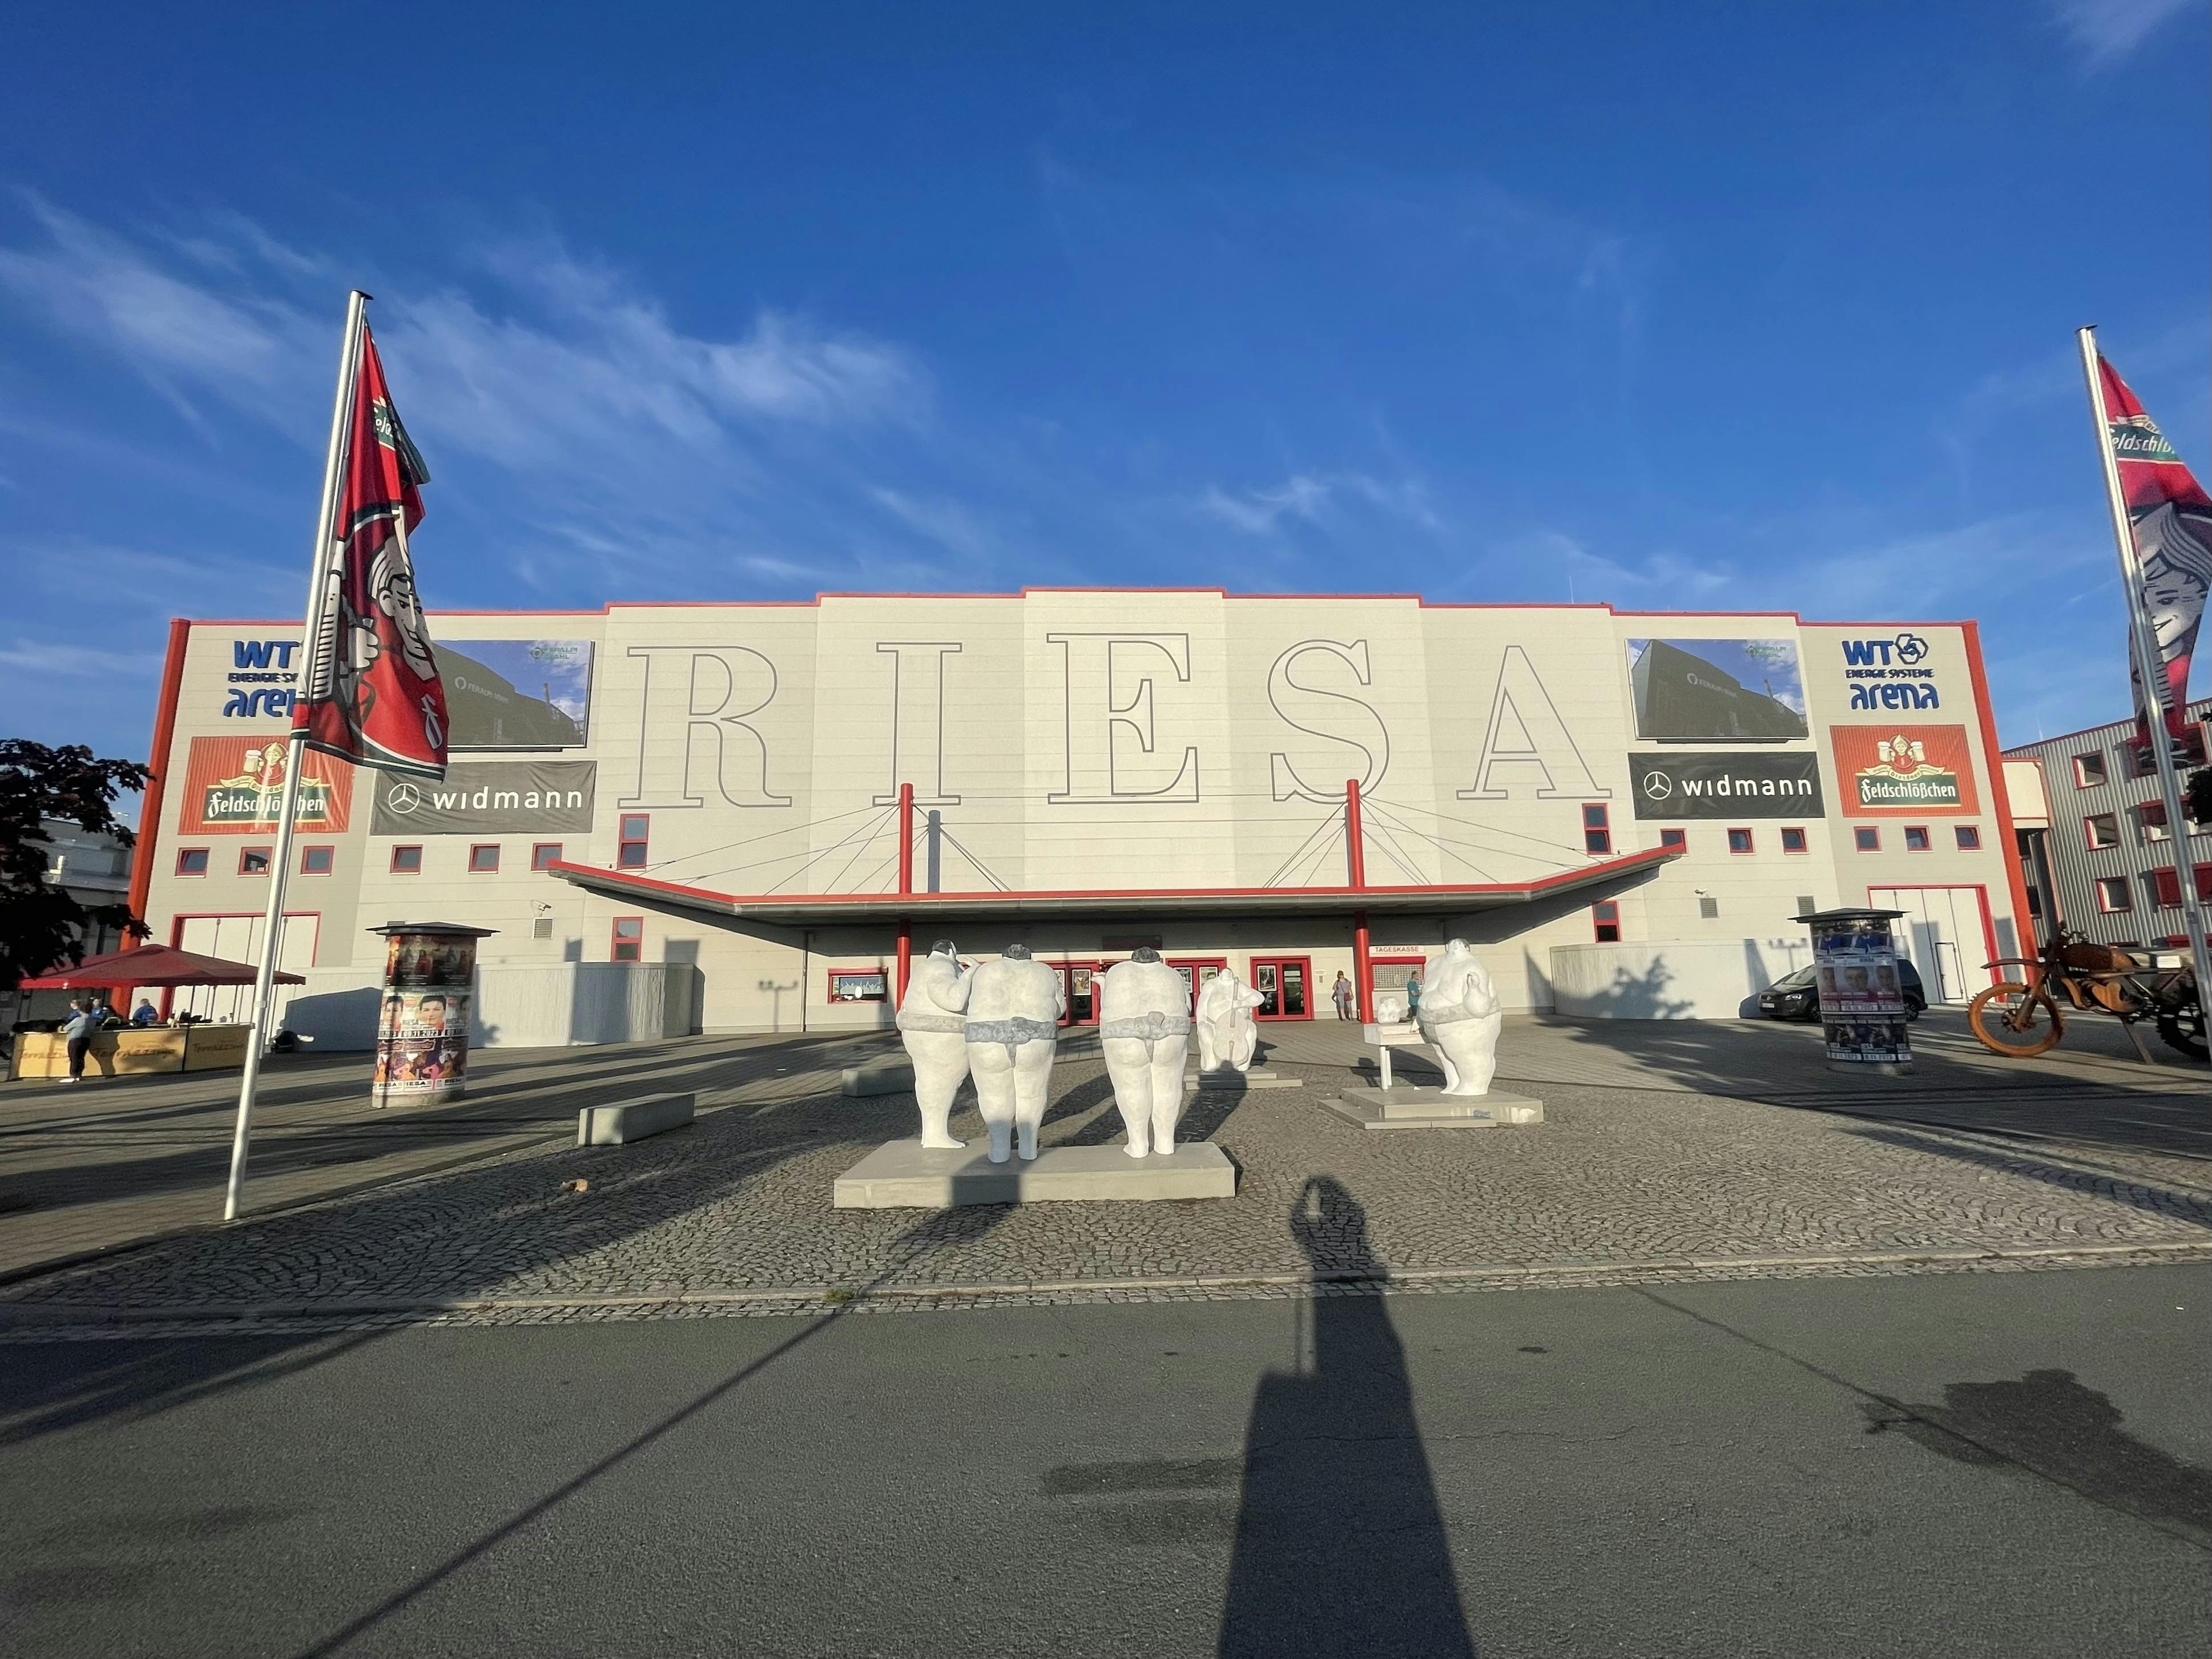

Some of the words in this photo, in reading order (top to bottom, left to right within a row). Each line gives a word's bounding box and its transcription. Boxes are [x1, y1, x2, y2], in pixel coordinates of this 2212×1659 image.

[234, 641, 300, 669] WT
[1842, 640, 1894, 666] WT
[1845, 669, 1887, 678] ENERGIE
[1888, 669, 1935, 678] SYSTEME
[1850, 683, 1940, 710] arena
[617, 633, 1613, 808] RIESA
[1681, 774, 1813, 797] widmann
[1890, 771, 1921, 781] Dresdner
[432, 786, 583, 810] widmann
[1860, 778, 1956, 803] Feldschlößchen
[207, 791, 324, 818] Feldschlöhen
